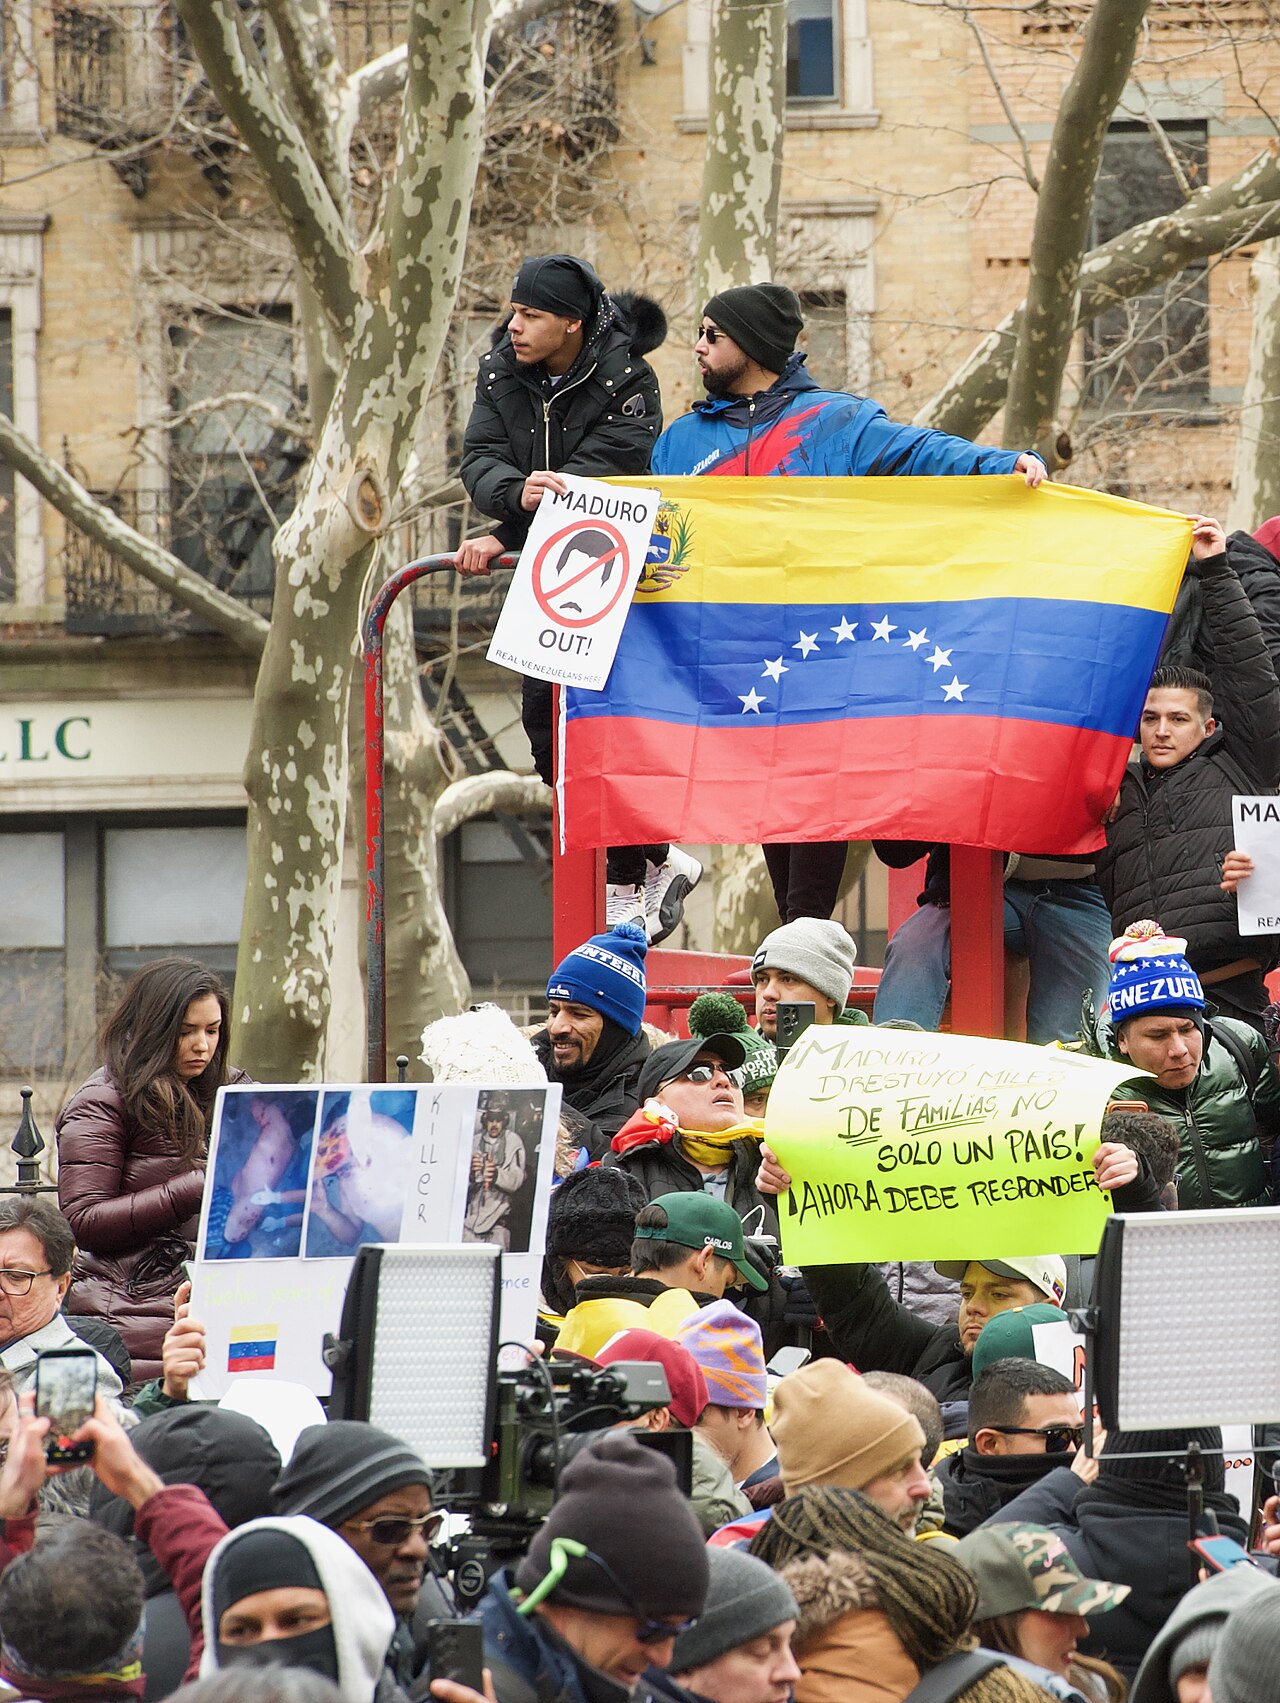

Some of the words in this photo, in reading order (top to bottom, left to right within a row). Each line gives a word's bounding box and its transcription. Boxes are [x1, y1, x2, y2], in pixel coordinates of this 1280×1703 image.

[552, 490, 648, 524] MADURO
[538, 629, 593, 656] OUT!
[495, 650, 518, 665] REAL
[521, 659, 582, 681] VENEZUELANS
[584, 674, 602, 685] HERE
[0, 717, 92, 761] LC
[838, 1105, 883, 1139] DE
[1011, 1089, 1058, 1118] NO
[877, 1140, 942, 1172] SOLO
[953, 1135, 994, 1166] UN
[1004, 1121, 1086, 1163] PAÍS!
[883, 1186, 960, 1214] DEBE
[704, 1236, 733, 1250] CARLOS
